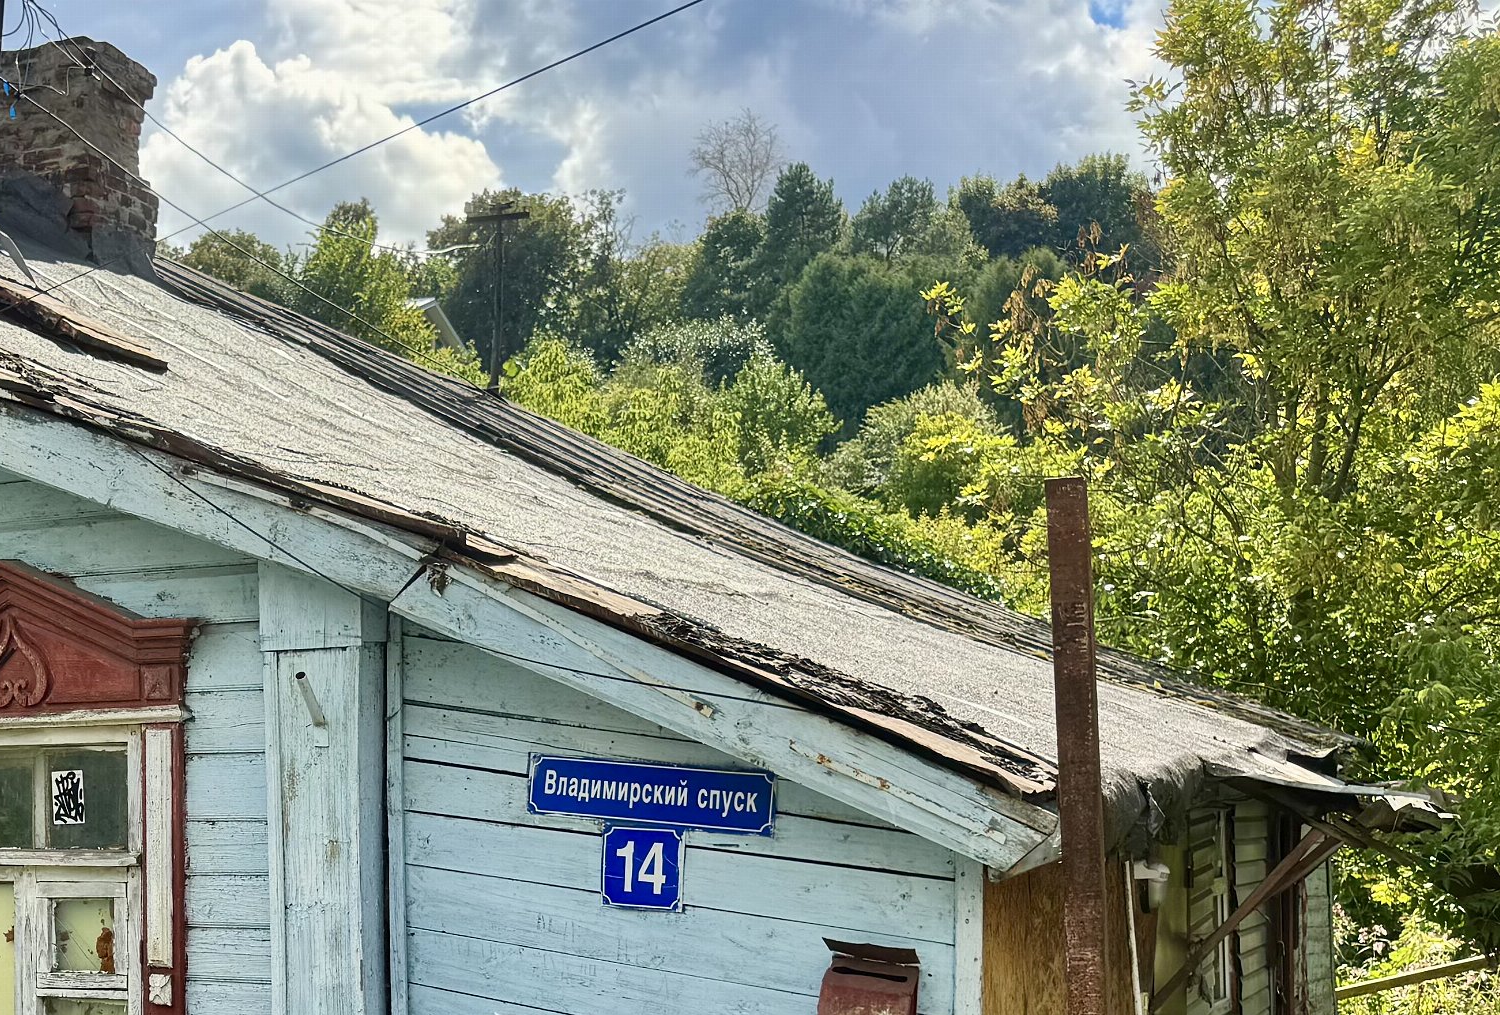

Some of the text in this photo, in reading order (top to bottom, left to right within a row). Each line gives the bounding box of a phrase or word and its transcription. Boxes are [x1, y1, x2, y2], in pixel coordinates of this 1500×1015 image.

[544, 769, 757, 817] Владимирский спуск
[616, 840, 666, 894] 14
